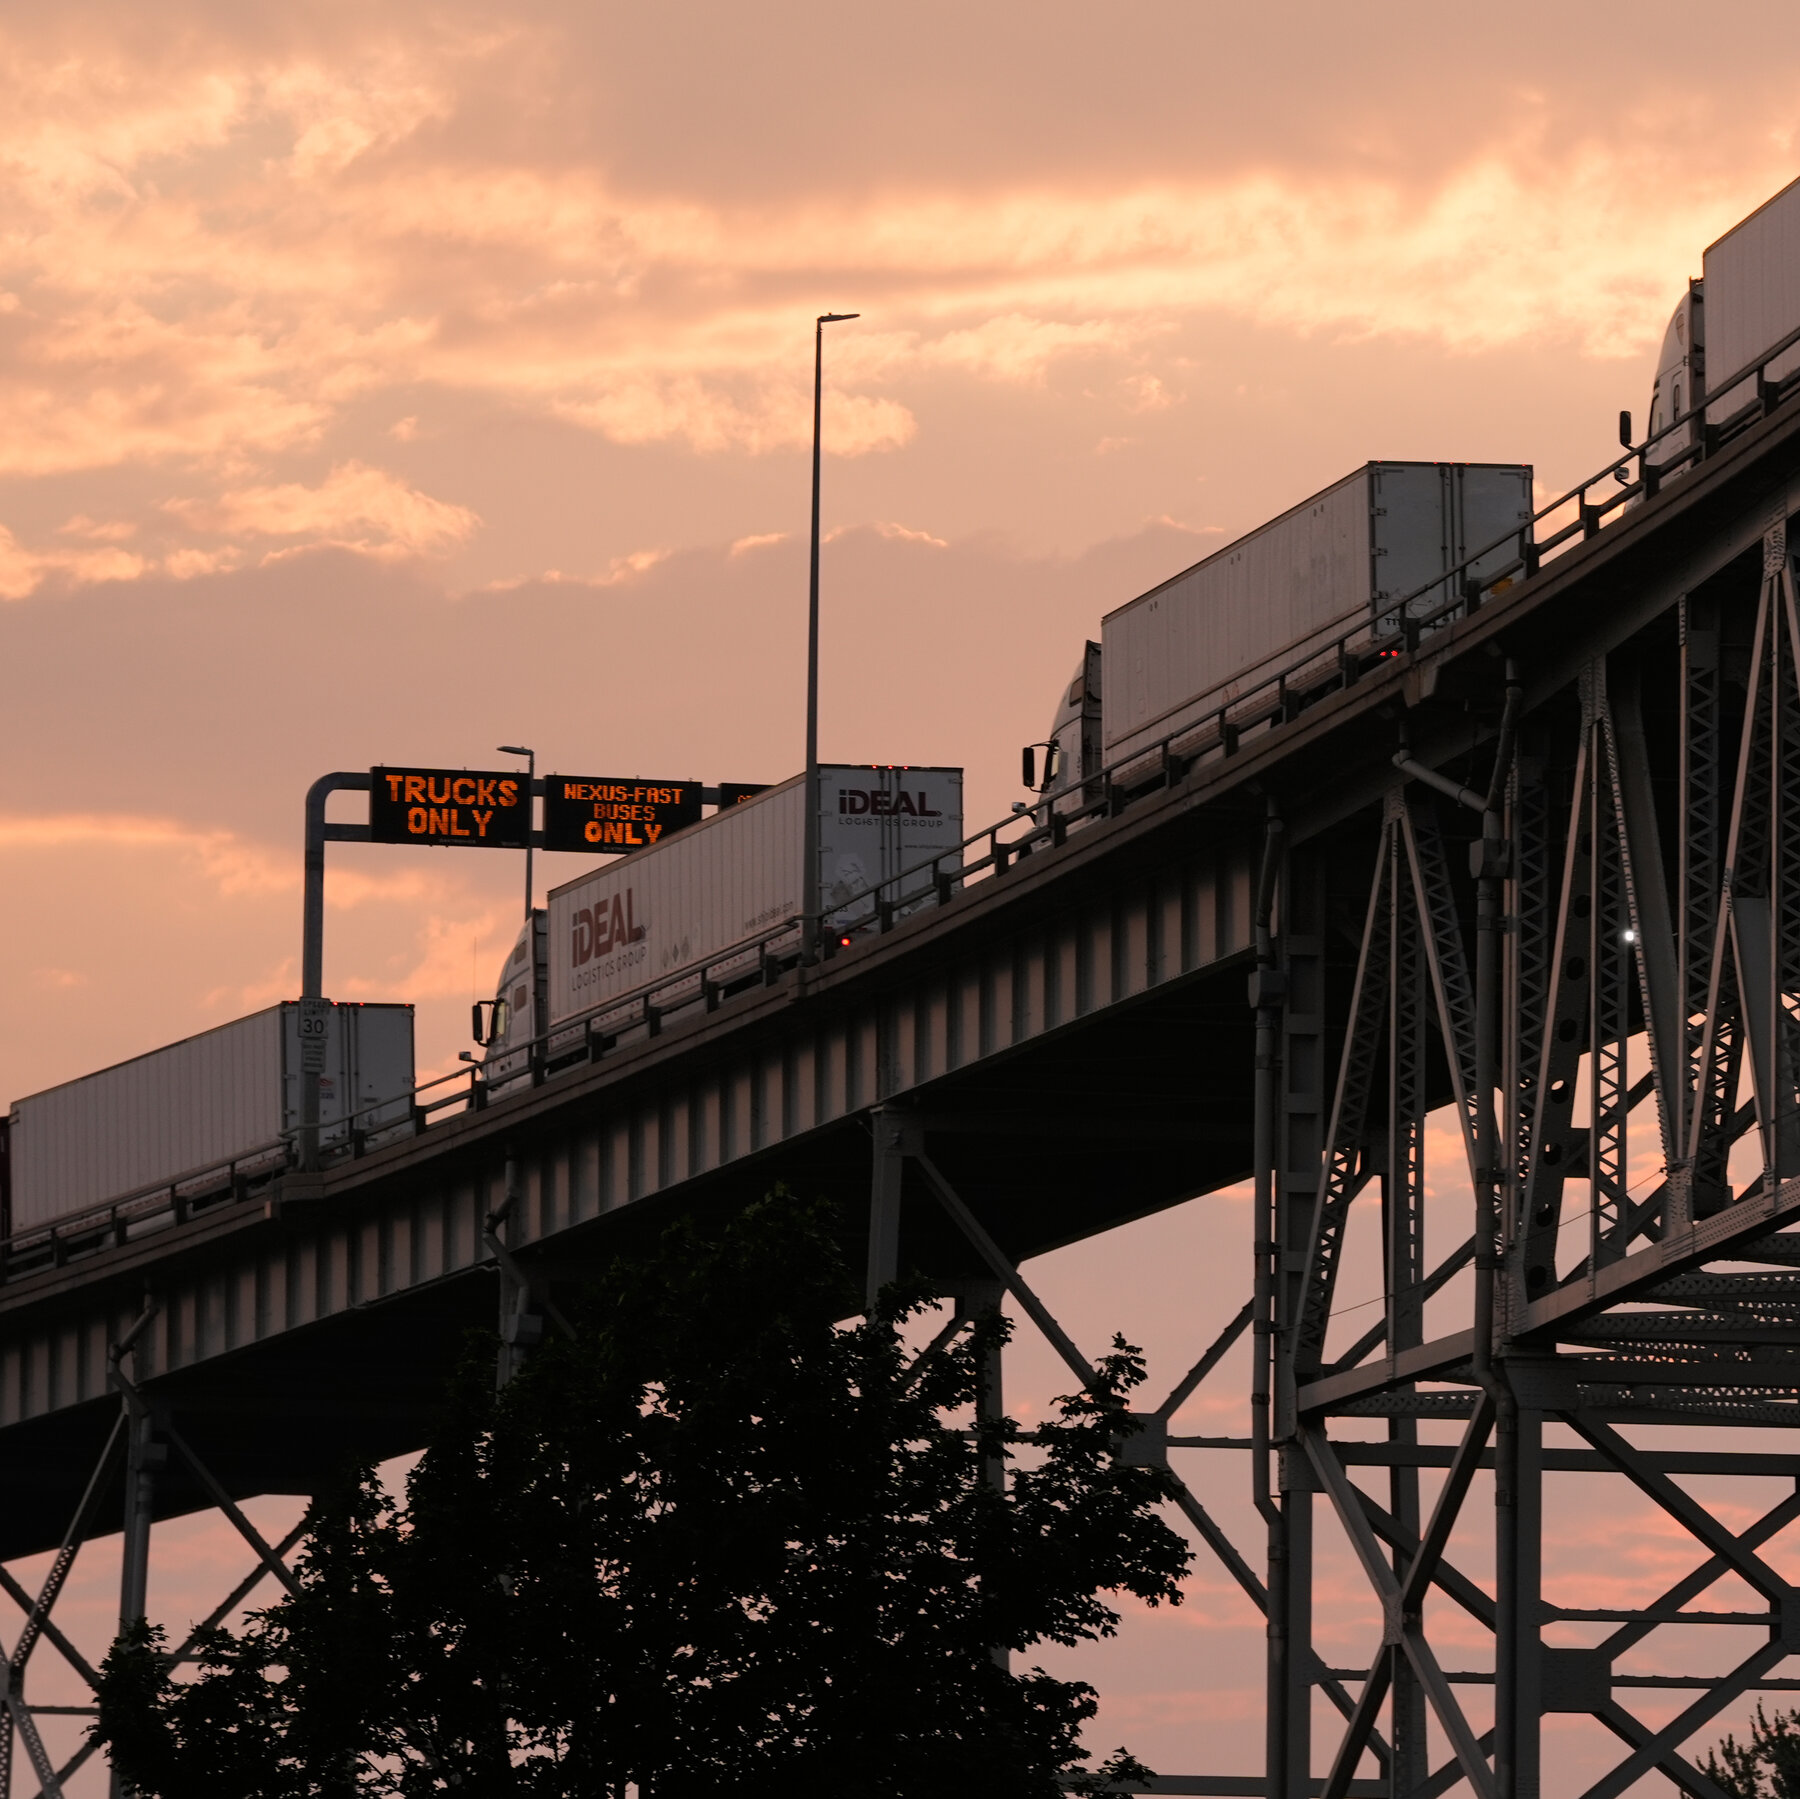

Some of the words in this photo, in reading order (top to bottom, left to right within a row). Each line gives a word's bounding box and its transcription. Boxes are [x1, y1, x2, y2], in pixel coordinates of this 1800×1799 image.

[385, 774, 519, 807] TRUCKS
[564, 783, 684, 804] NEXUS-FAST
[407, 806, 494, 837] ONLY
[593, 803, 656, 821] BUSES
[838, 817, 900, 826] LOGISTCS
[902, 819, 943, 827] GROUP
[584, 820, 663, 845] ONLY
[572, 960, 615, 992] LOGISTICS
[617, 946, 647, 972] GROUP
[303, 1018, 325, 1034] 30
